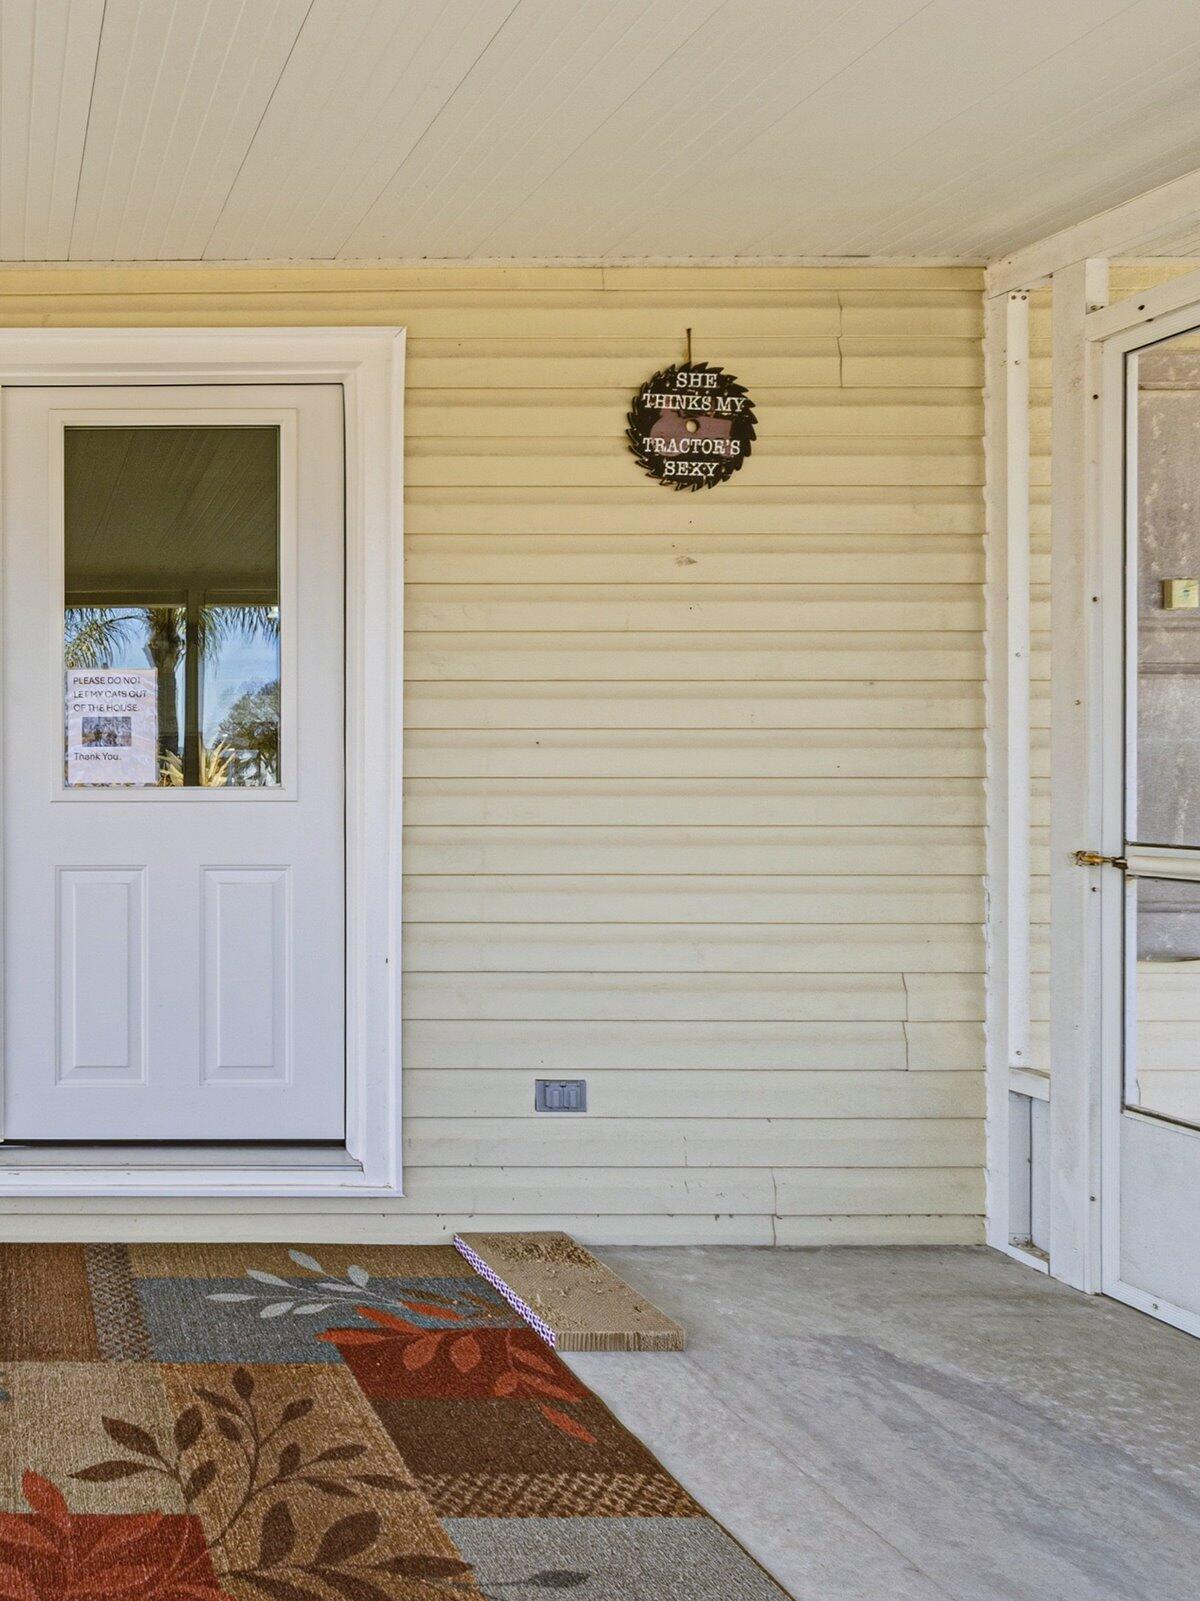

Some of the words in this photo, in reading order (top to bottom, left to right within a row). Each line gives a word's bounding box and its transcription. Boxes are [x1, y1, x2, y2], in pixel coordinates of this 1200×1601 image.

[676, 372, 717, 388] SHE
[643, 393, 711, 411] THINKS
[716, 396, 746, 412] MY
[642, 437, 741, 455] TRACTOR'S
[664, 461, 719, 477] SEXY
[73, 676, 106, 685] PLEASE
[107, 676, 121, 685] DO
[123, 676, 141, 685] NOT
[73, 690, 90, 699] LET
[90, 690, 103, 698] MY
[128, 689, 147, 698] OUT
[73, 703, 87, 712] OF
[87, 703, 105, 712] THE
[73, 752, 100, 761] Thank
